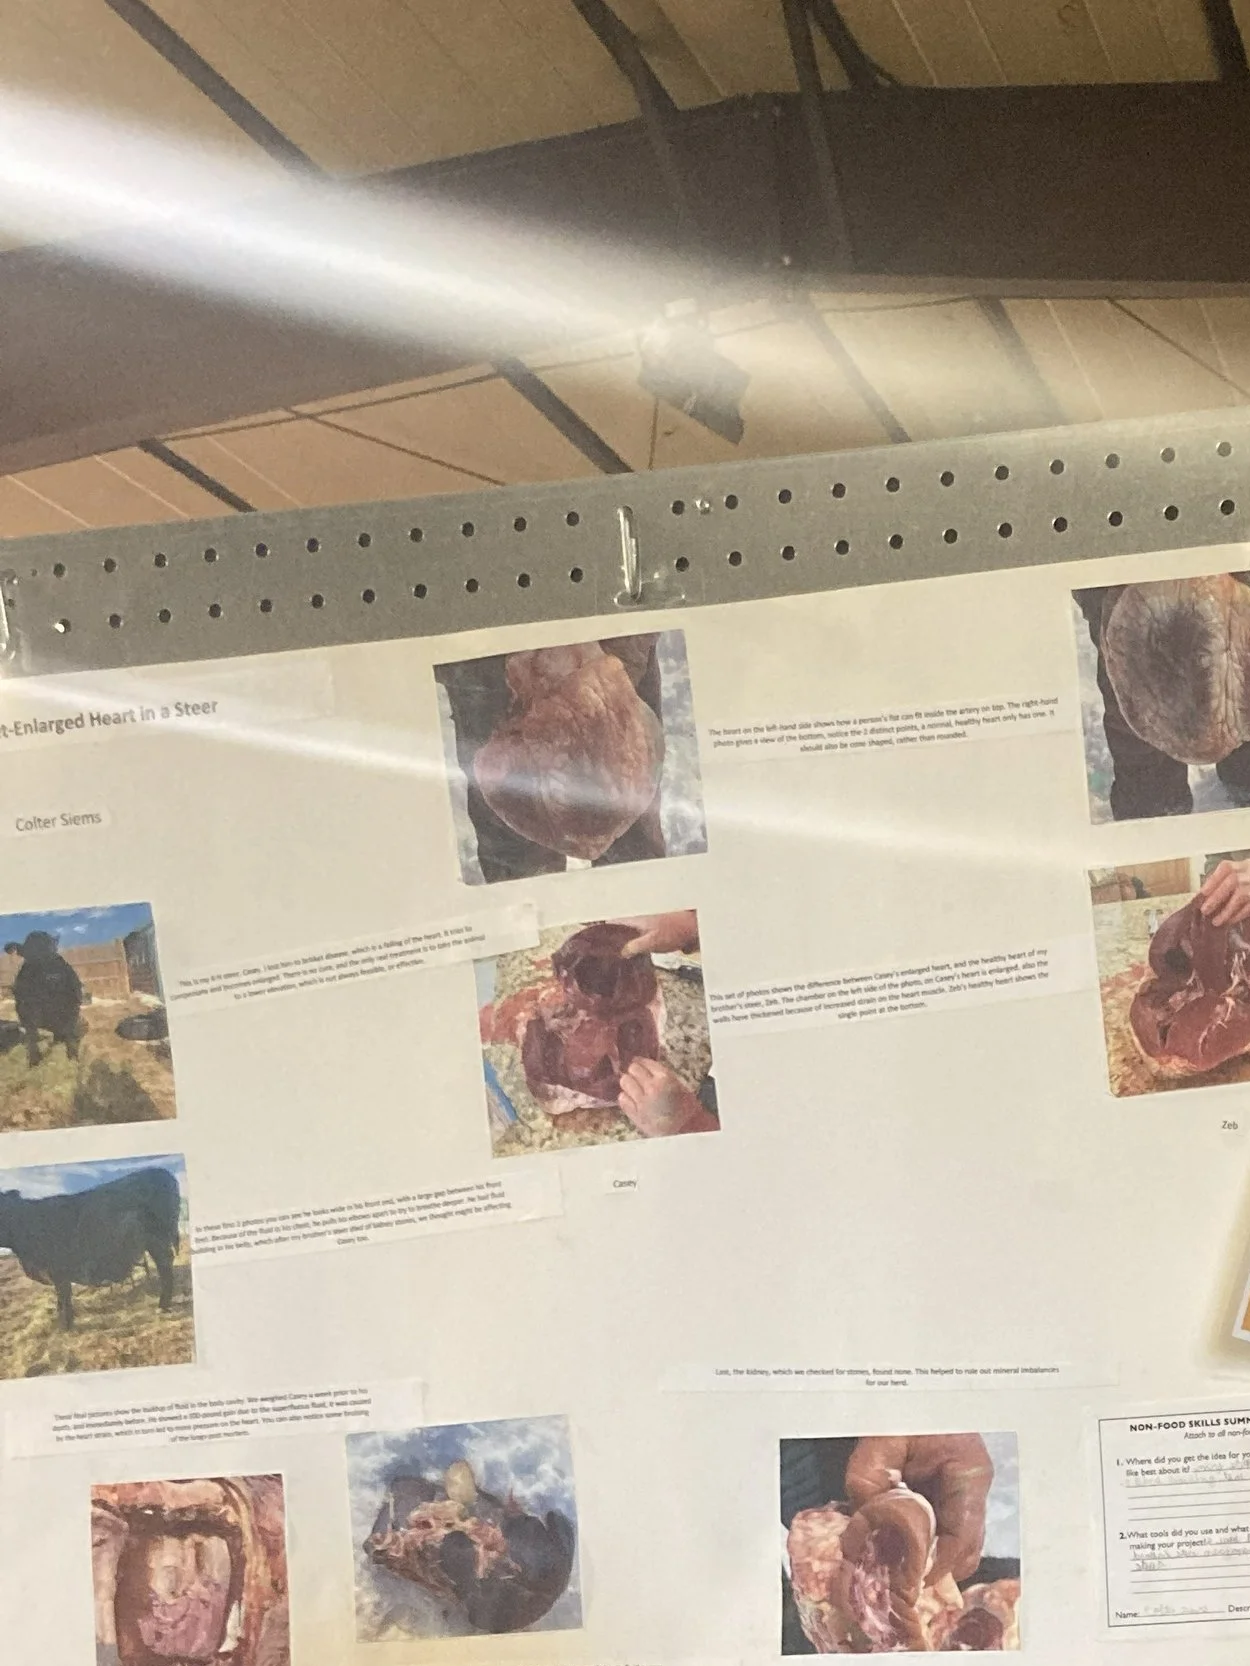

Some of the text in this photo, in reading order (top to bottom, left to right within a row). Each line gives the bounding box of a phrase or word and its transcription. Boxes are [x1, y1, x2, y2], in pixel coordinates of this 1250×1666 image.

[0, 701, 218, 739] t-Enlarged Heart in a Steer
[15, 812, 103, 832] Colter Siems
[1221, 1119, 1239, 1130] Zeb
[1129, 1420, 1186, 1432] NON-FOOD
[1188, 1418, 1221, 1428] SKILLS
[1125, 1457, 1153, 1466] Where
[1153, 1455, 1166, 1465] did
[1167, 1456, 1182, 1466] you
[1183, 1455, 1196, 1465] get
[1196, 1453, 1210, 1462] the
[1210, 1452, 1227, 1461] idea
[1228, 1450, 1241, 1460] for
[1149, 1529, 1170, 1539] tools
[1170, 1528, 1183, 1537] did
[1184, 1529, 1199, 1538] you
[1200, 1528, 1214, 1536] use
[1214, 1525, 1229, 1535] and
[1229, 1525, 1250, 1533] what
[1114, 1611, 1139, 1619] Name:
